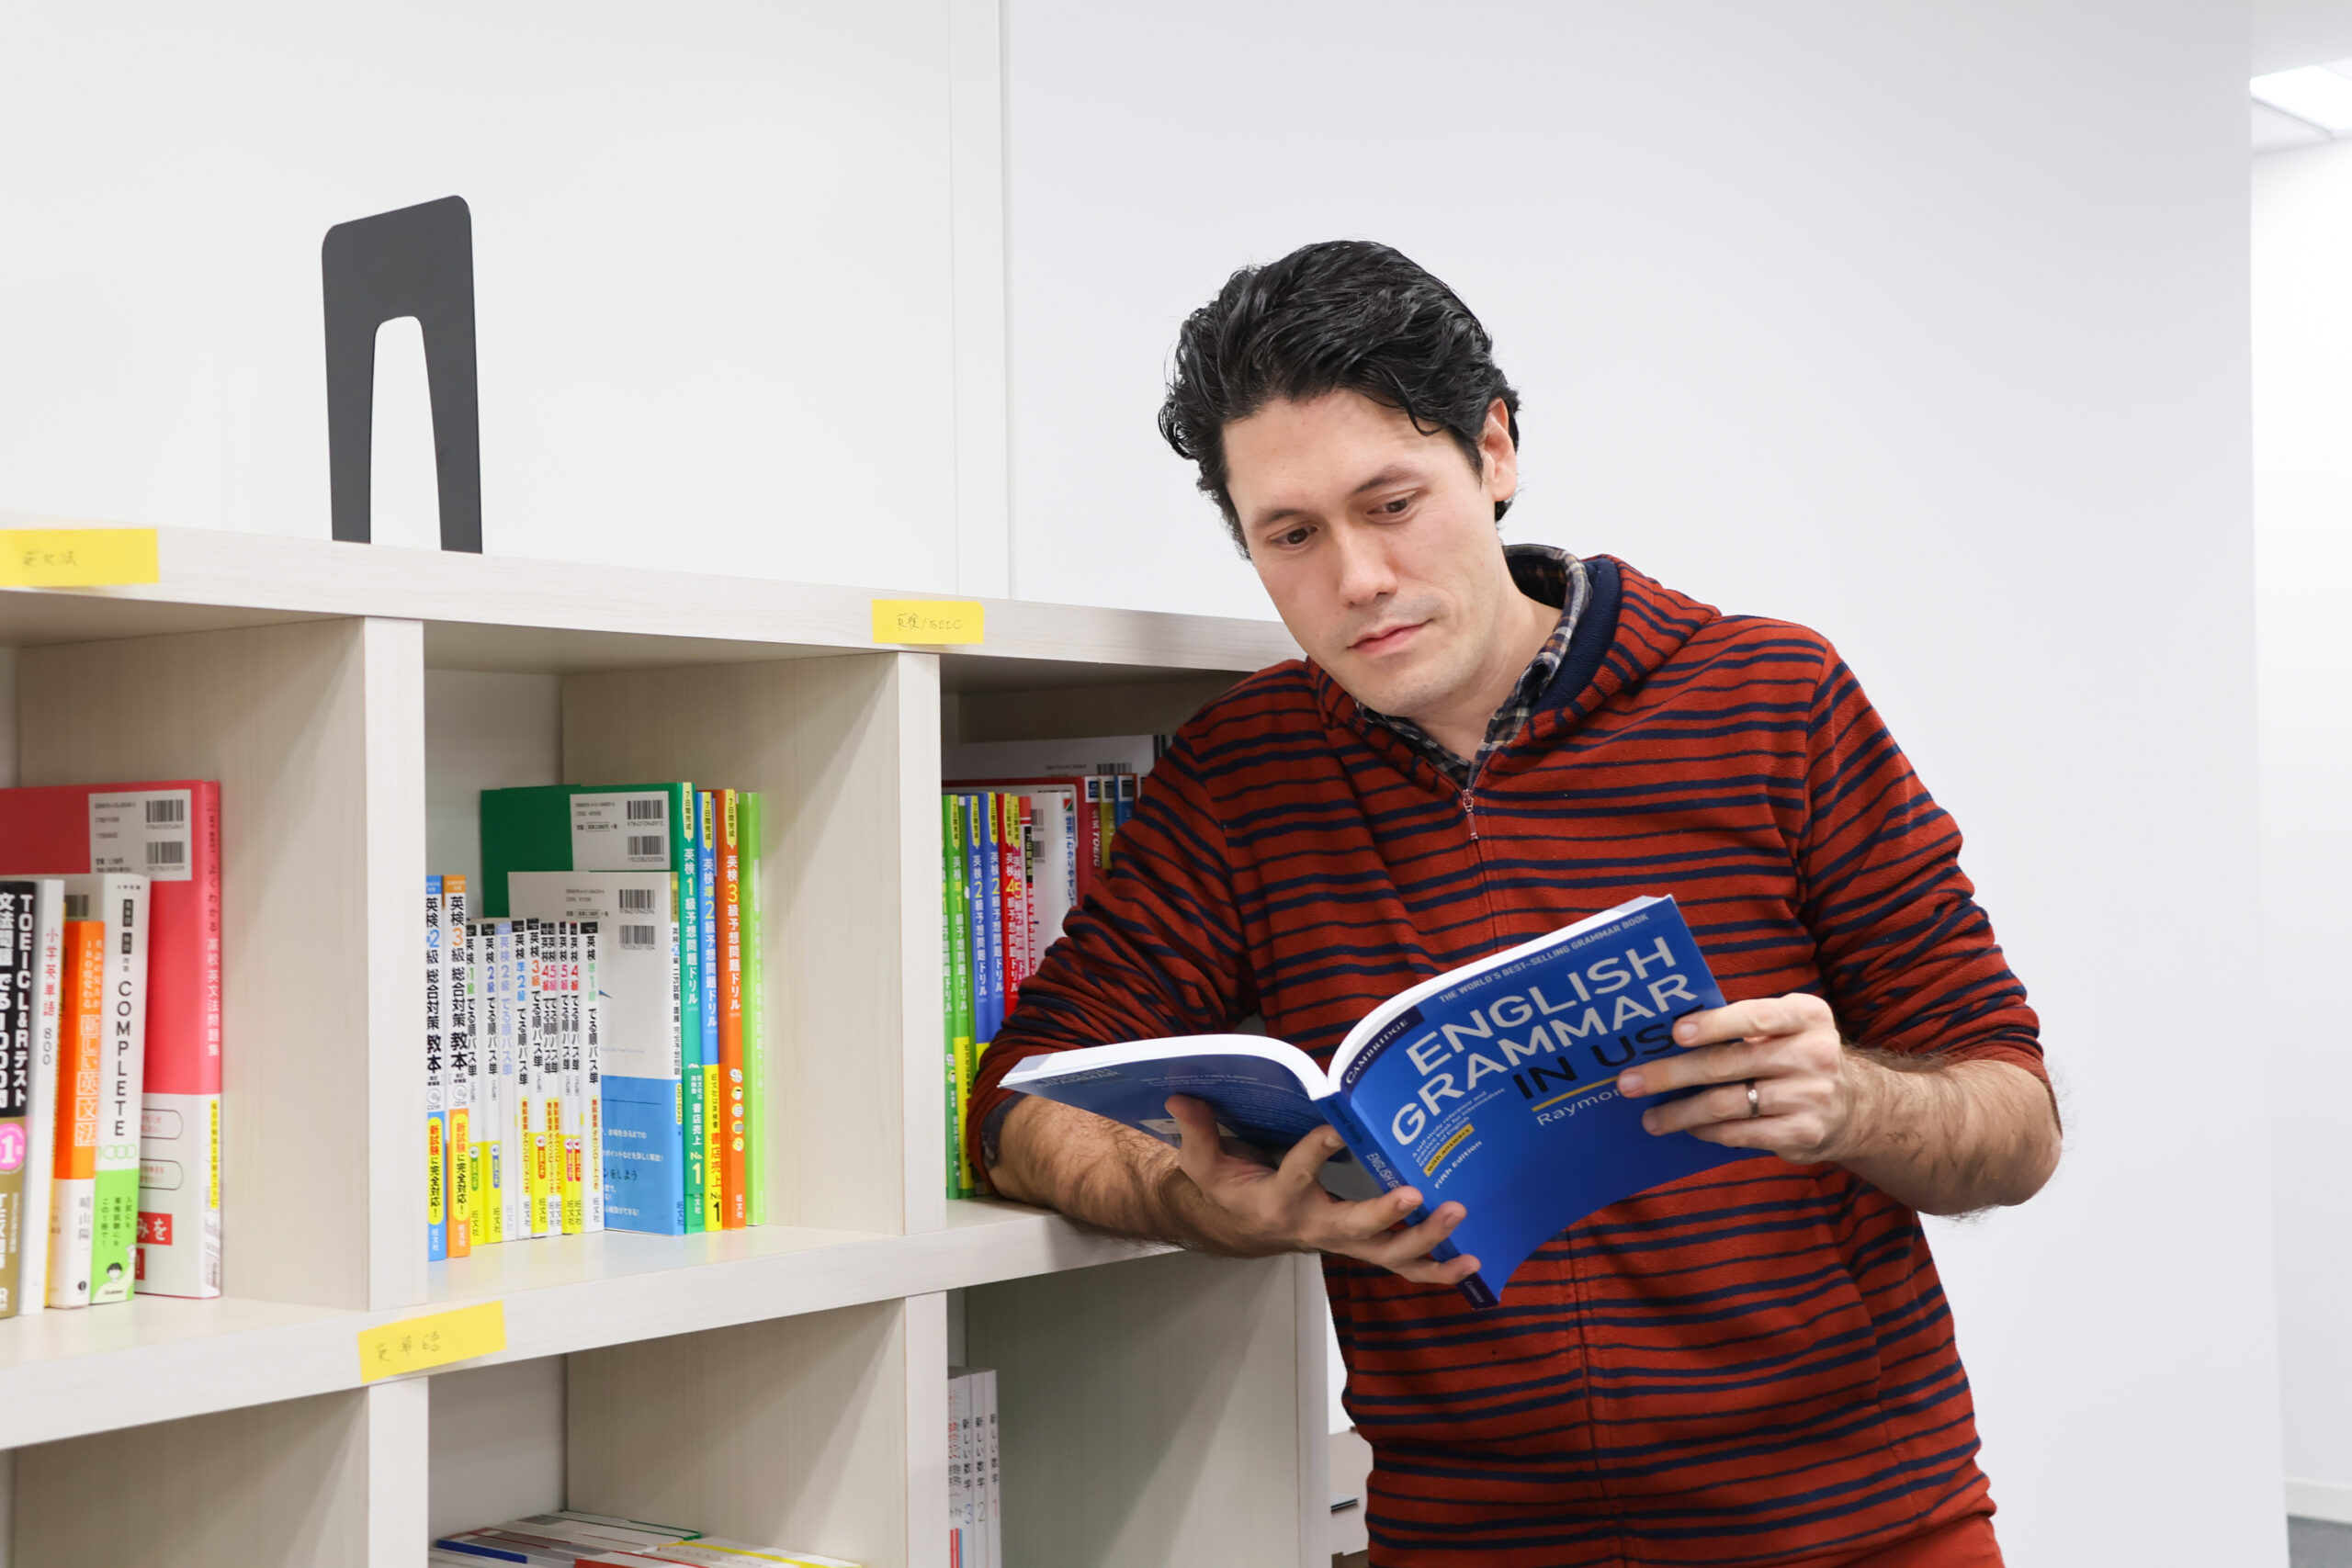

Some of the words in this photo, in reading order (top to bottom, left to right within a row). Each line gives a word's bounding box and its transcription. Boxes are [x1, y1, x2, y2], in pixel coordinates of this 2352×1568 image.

[17, 892, 33, 988] TOEIC
[1439, 989, 1458, 1004] THE
[1457, 972, 1501, 995] WORLD'S
[1502, 945, 1570, 977] BEST-SELLING
[1571, 924, 1622, 951] GRAMMAR
[1622, 913, 1649, 931] BOOK
[1406, 936, 1678, 1077] ENGLISH
[115, 980, 132, 1136] COMPLETE
[1346, 1019, 1409, 1085] CAMBRIDGE
[1391, 974, 1699, 1146] GRAMMAR
[1512, 1055, 1578, 1100] IN
[1590, 1004, 1703, 1067] US
[1447, 1116, 1470, 1136] English
[1462, 1088, 1506, 1116] intermediate
[1366, 1152, 1395, 1183] ENGLISH
[1427, 1155, 1442, 1172] with
[1442, 1128, 1470, 1156] answers
[1452, 1141, 1482, 1168] Edition
